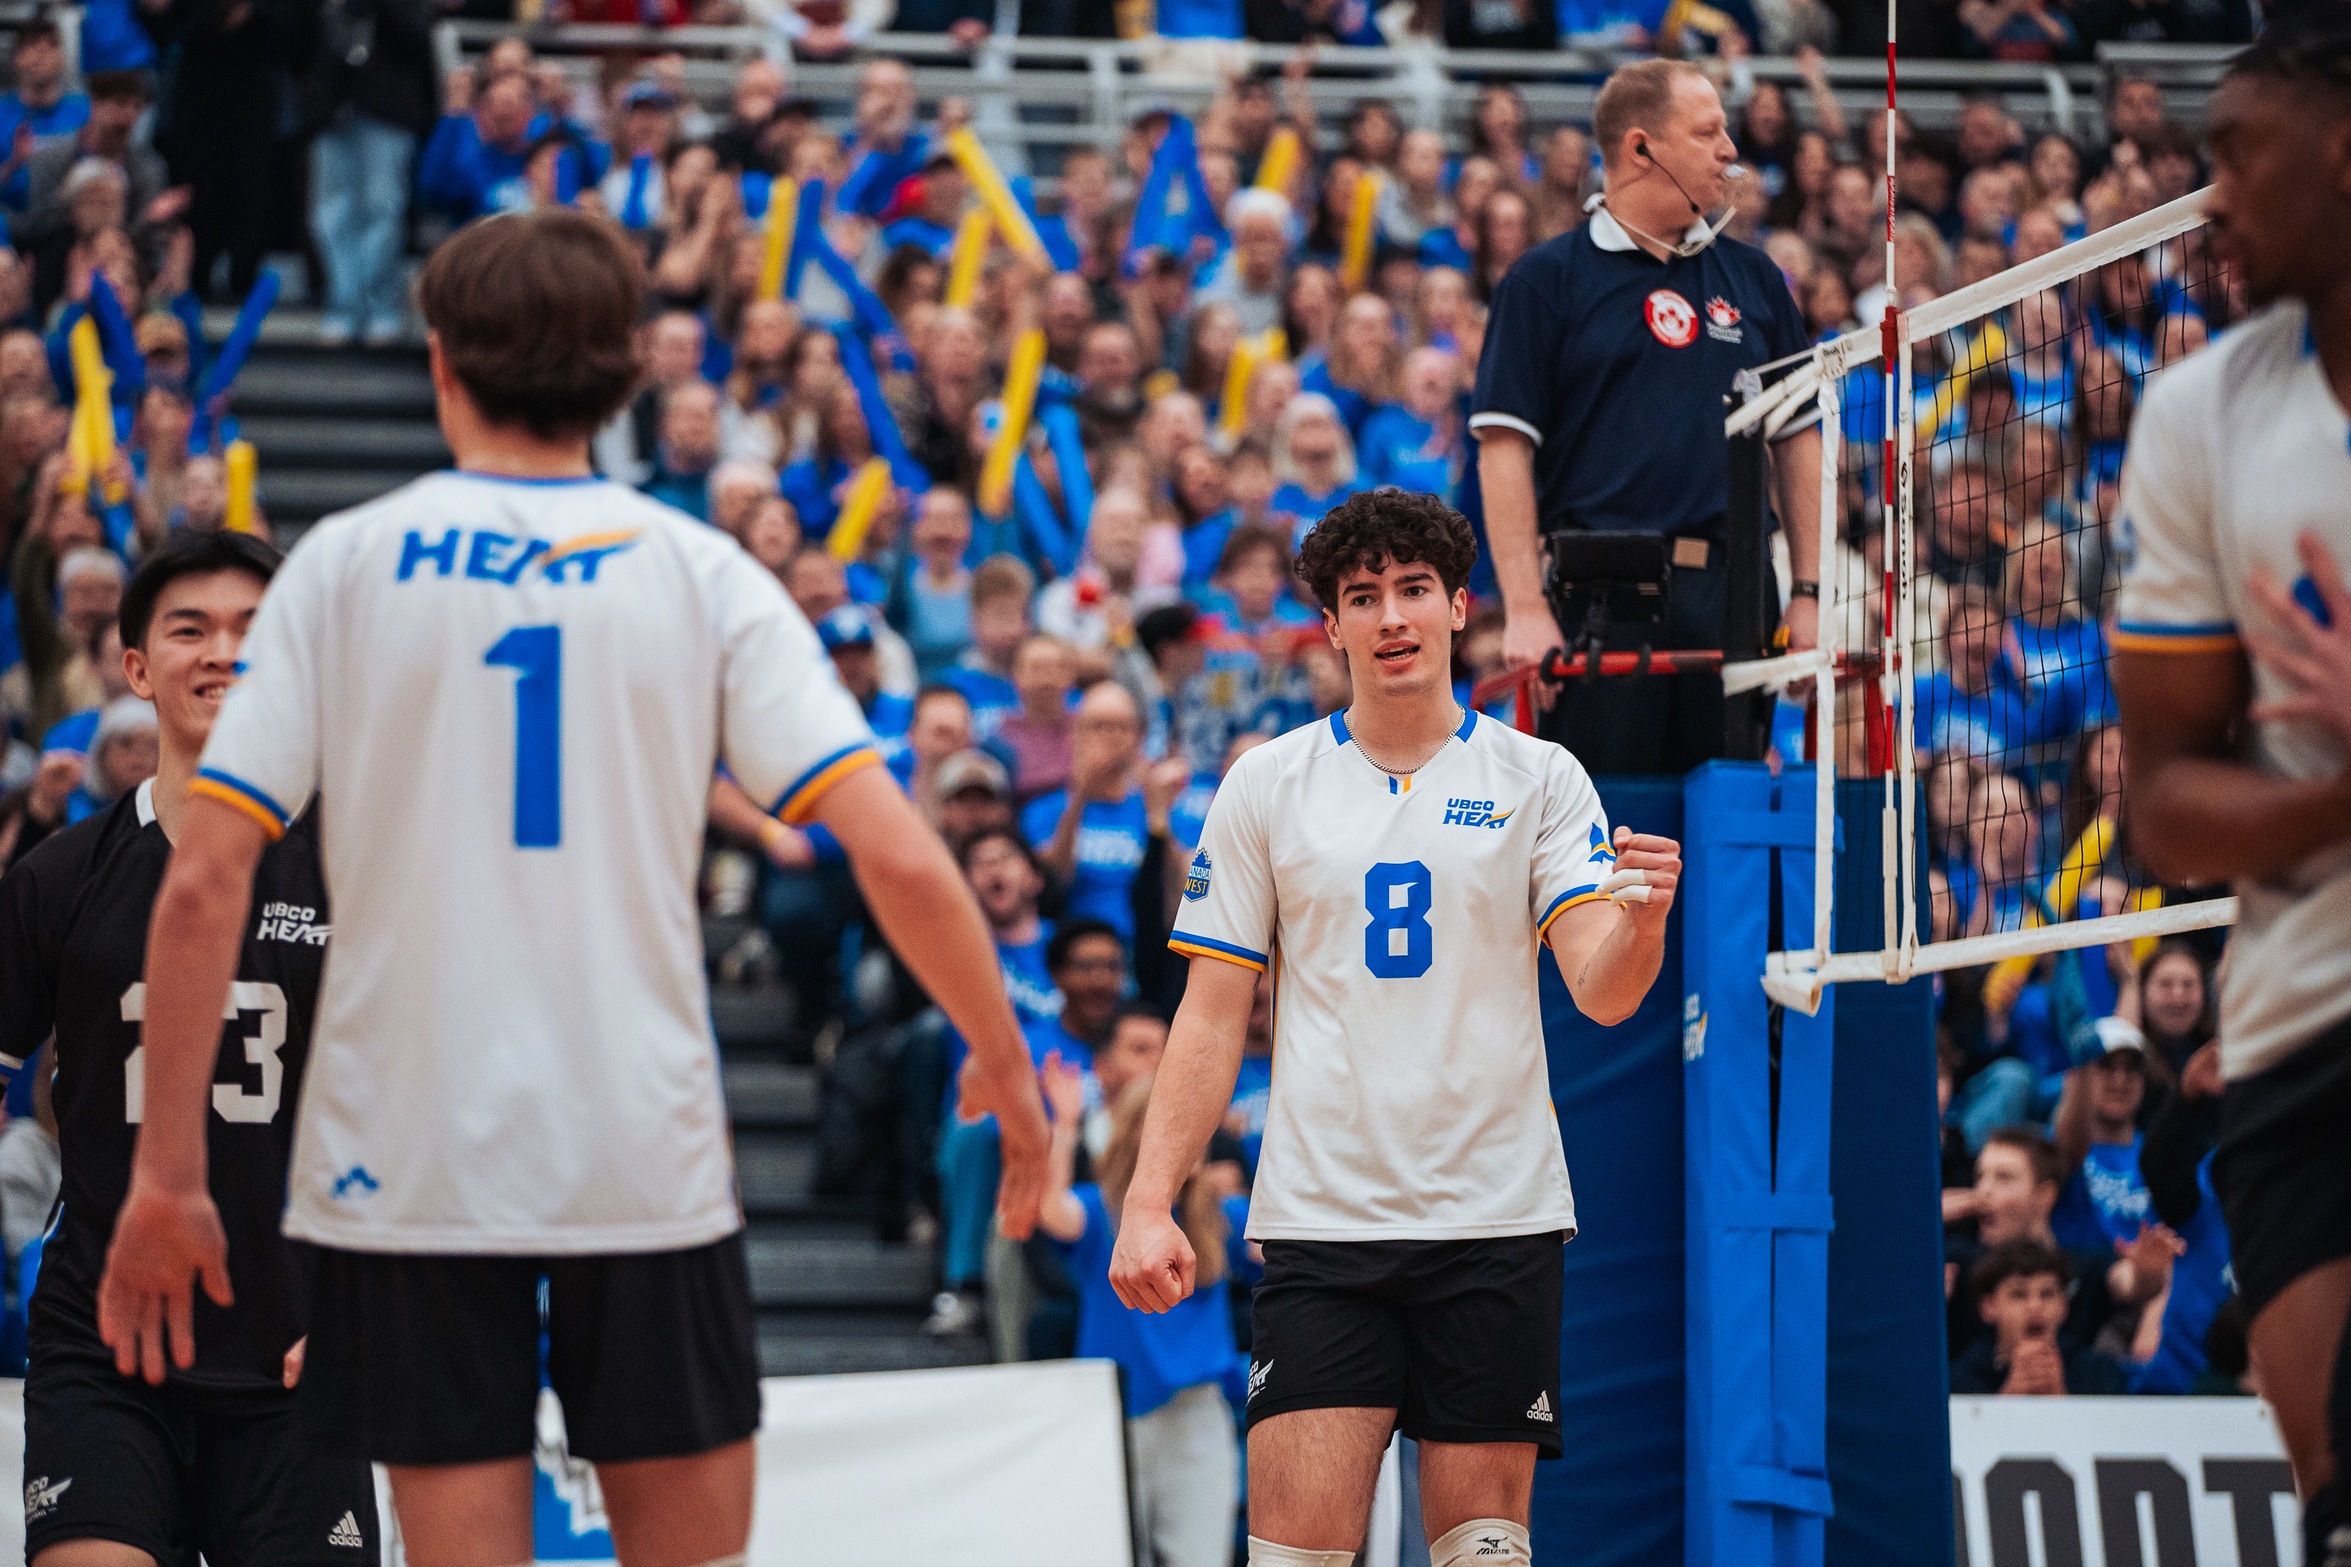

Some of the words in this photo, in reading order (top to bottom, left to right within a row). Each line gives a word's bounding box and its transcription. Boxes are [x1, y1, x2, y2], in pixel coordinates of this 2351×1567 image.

[397, 526, 643, 586] HEAT
[484, 625, 561, 848] 1
[1446, 798, 1495, 811] UBCO
[1442, 805, 1517, 829] HEAT
[263, 902, 316, 922] UBCO
[1364, 860, 1432, 979] 8
[1526, 1409, 1553, 1422] adidas
